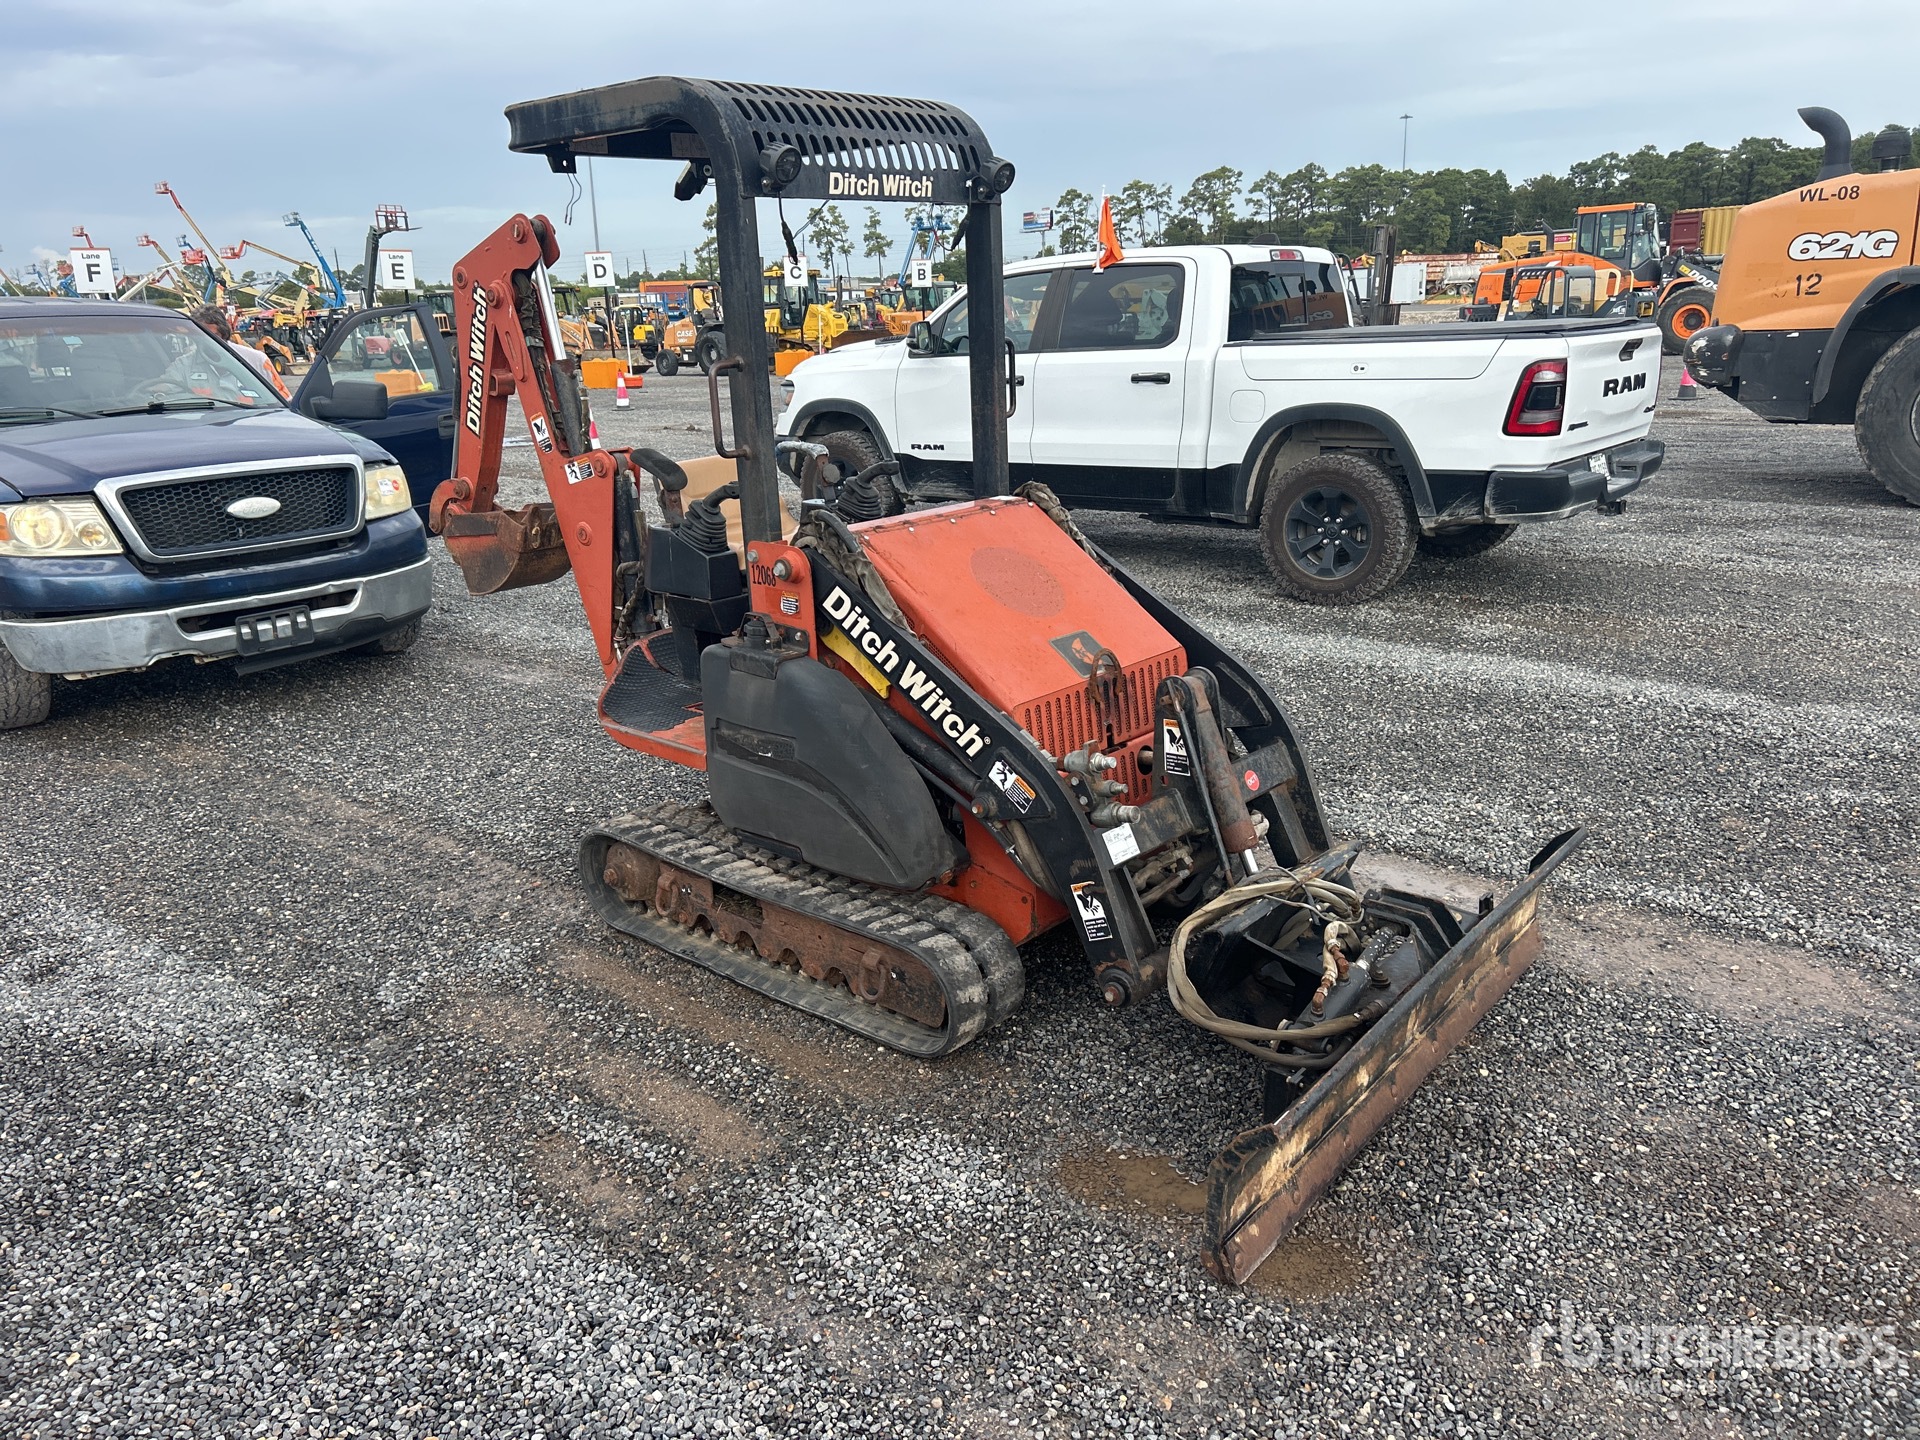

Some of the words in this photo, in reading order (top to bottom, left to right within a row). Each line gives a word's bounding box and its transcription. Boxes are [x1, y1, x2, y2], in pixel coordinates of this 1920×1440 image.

[829, 171, 879, 196] Ditch
[882, 173, 933, 197] Witch
[1800, 185, 1860, 202] WL-08
[1787, 229, 1900, 261] 621G
[86, 263, 101, 282] F
[391, 263, 405, 280] E
[593, 263, 607, 279] D
[790, 265, 802, 279] C
[917, 268, 926, 281] B
[1796, 273, 1823, 297] 12
[469, 286, 487, 364] Witch
[1602, 372, 1646, 397] RAM
[466, 363, 484, 436] Ditch
[910, 443, 945, 451] RAM
[751, 563, 777, 587] 12068
[822, 585, 900, 673] Ditch
